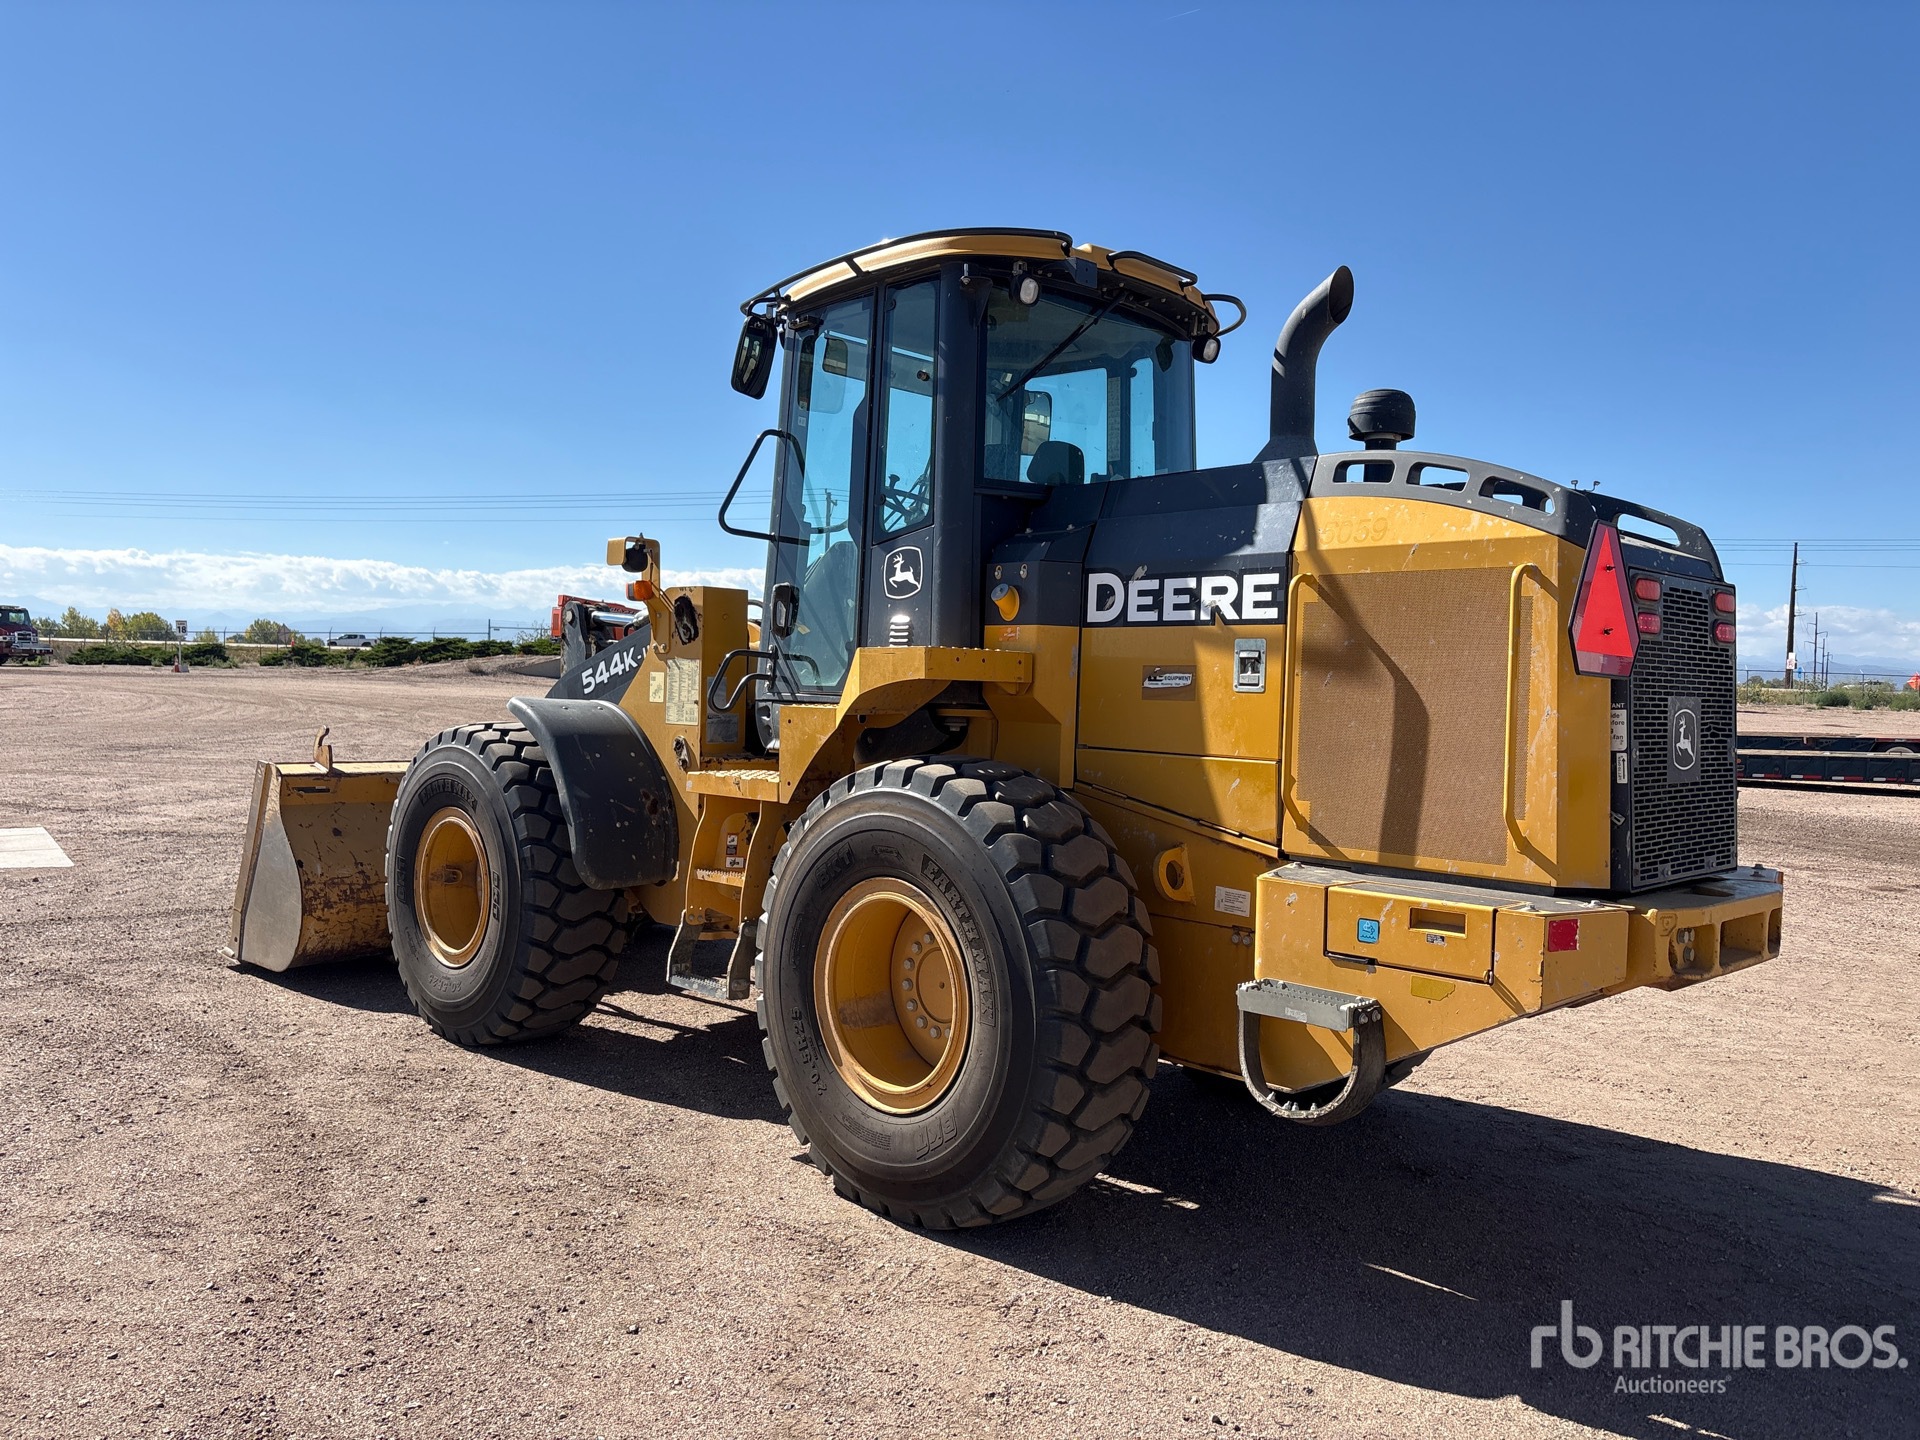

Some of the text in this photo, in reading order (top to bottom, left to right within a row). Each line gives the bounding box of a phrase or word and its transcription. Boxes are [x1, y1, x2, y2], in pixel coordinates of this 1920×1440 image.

[1087, 572, 1280, 623] DEERE
[177, 625, 187, 634] 18
[581, 644, 650, 695] 544K-I
[815, 842, 854, 889] BKT
[924, 860, 995, 1025] EARTH MAX
